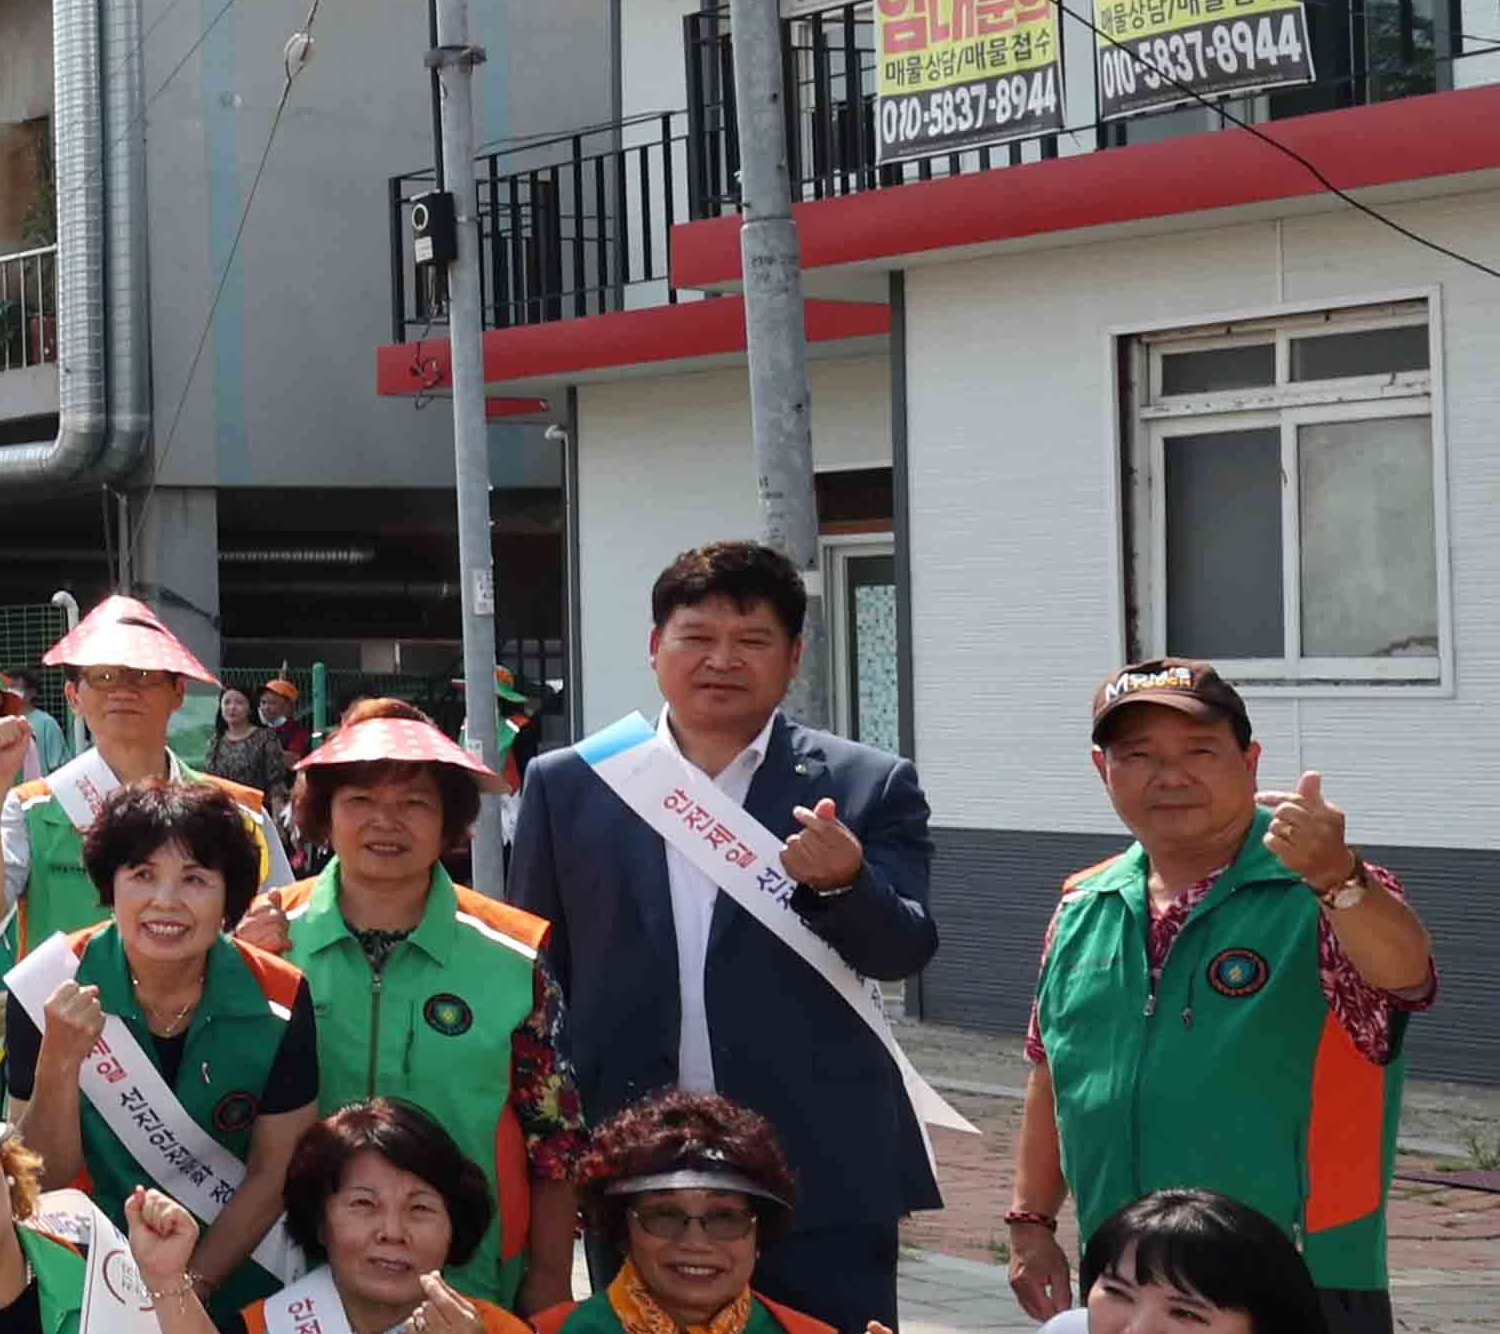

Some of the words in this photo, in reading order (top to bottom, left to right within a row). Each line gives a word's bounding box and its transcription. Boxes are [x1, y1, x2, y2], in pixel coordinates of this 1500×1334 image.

[885, 31, 1051, 85] 매물상담/매물접수
[1103, 14, 1301, 100] 010-5837-8944
[882, 70, 1056, 144] 010-5837-8944
[663, 787, 757, 869] 안전제일
